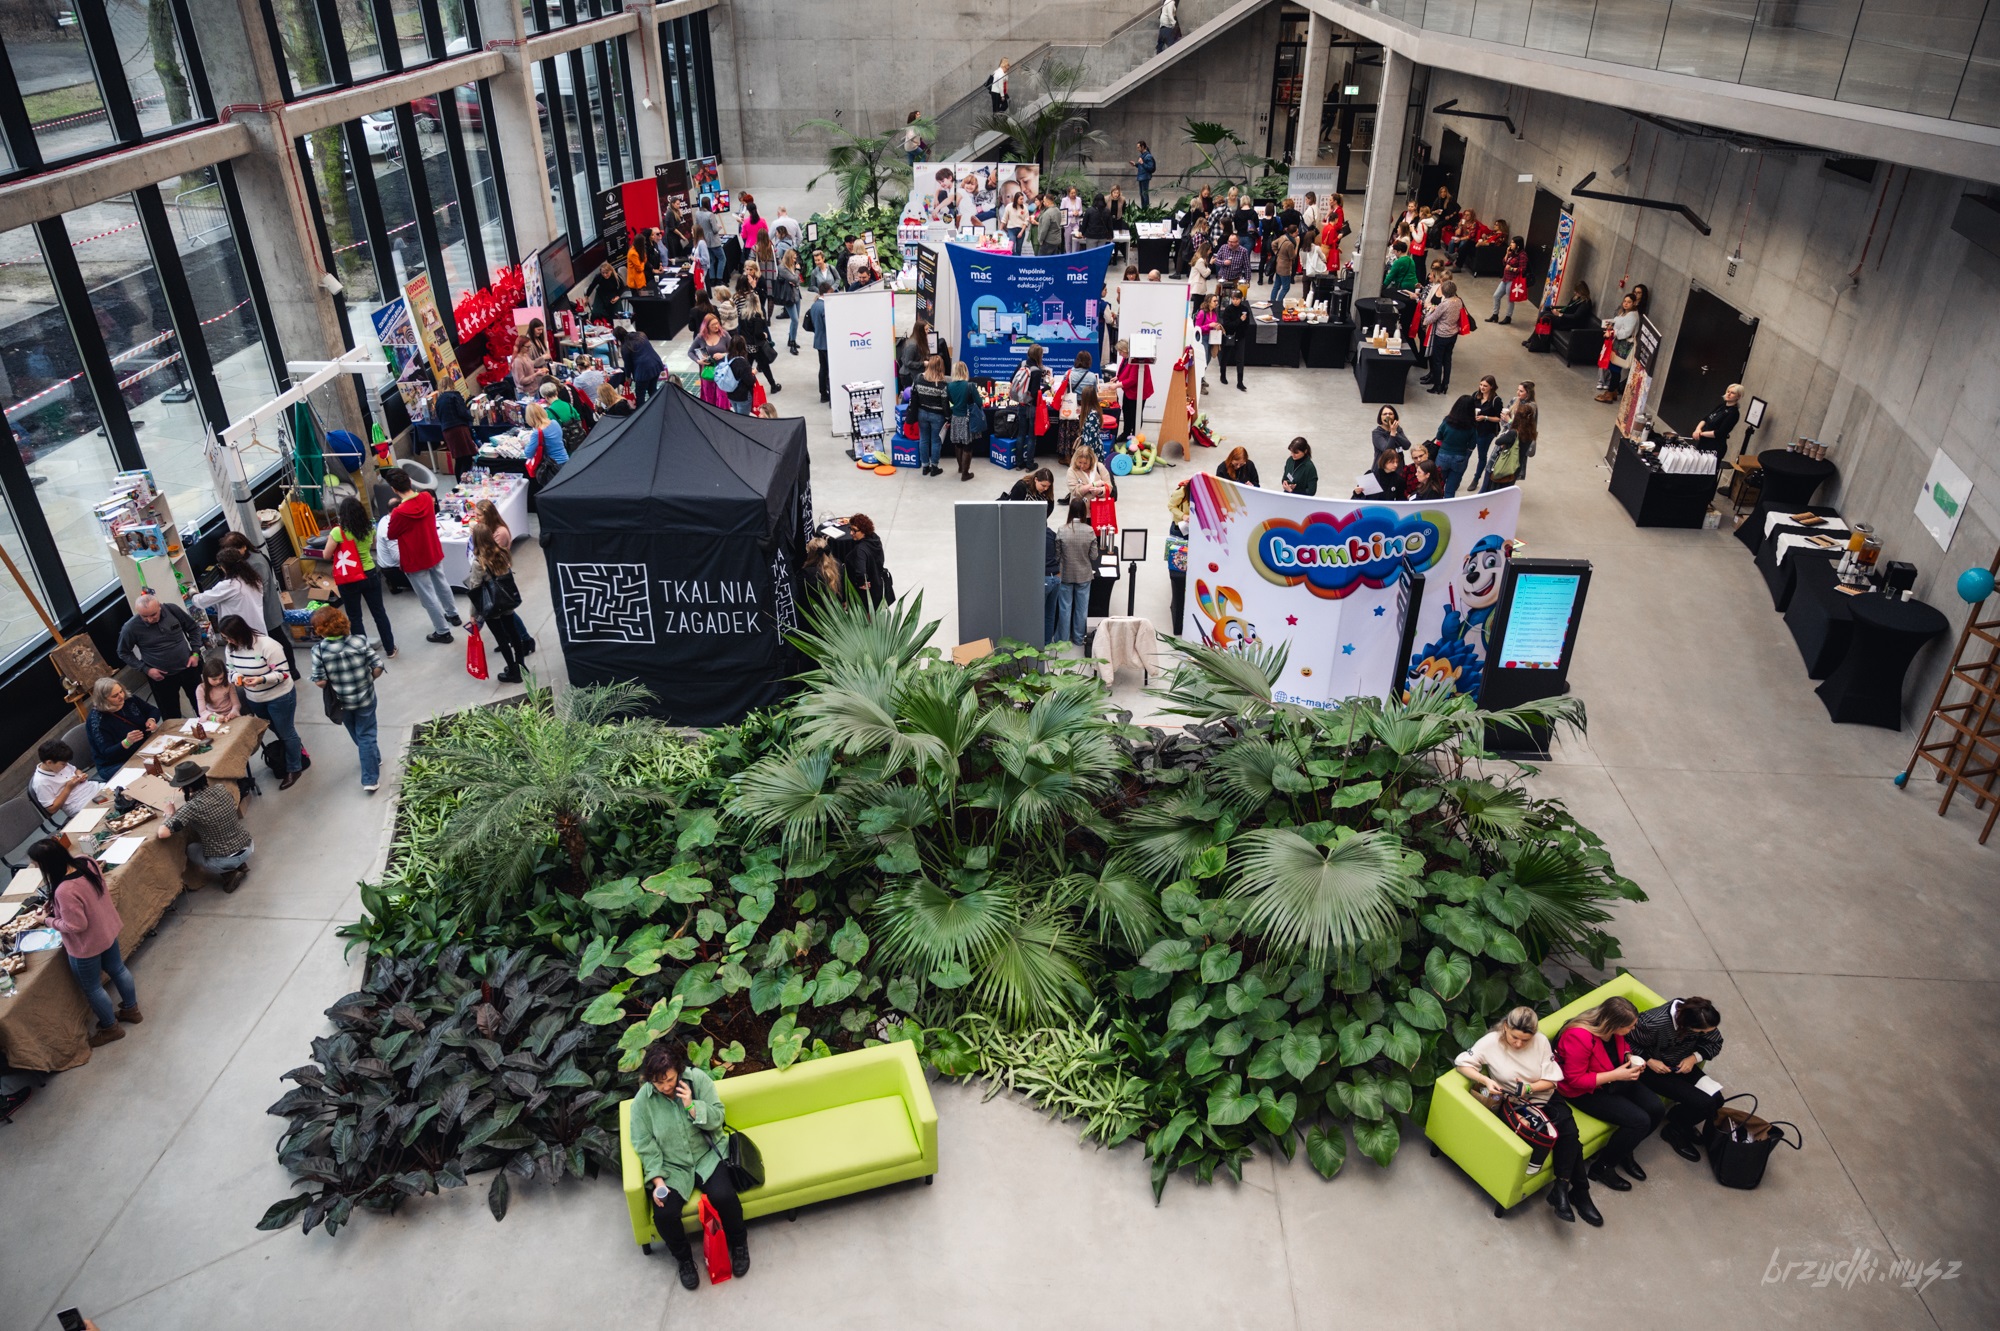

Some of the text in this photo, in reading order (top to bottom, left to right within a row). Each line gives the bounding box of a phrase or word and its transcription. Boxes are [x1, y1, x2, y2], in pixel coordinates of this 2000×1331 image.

[970, 272, 992, 280] mac
[1066, 273, 1089, 281] mac
[1140, 328, 1162, 336] mac
[850, 338, 872, 348] mac
[894, 453, 916, 462] mac
[991, 450, 1007, 463] mac
[658, 580, 757, 604] TKALNIA
[664, 611, 762, 634] ZAGADEK
[1290, 696, 1341, 711] st-majew
